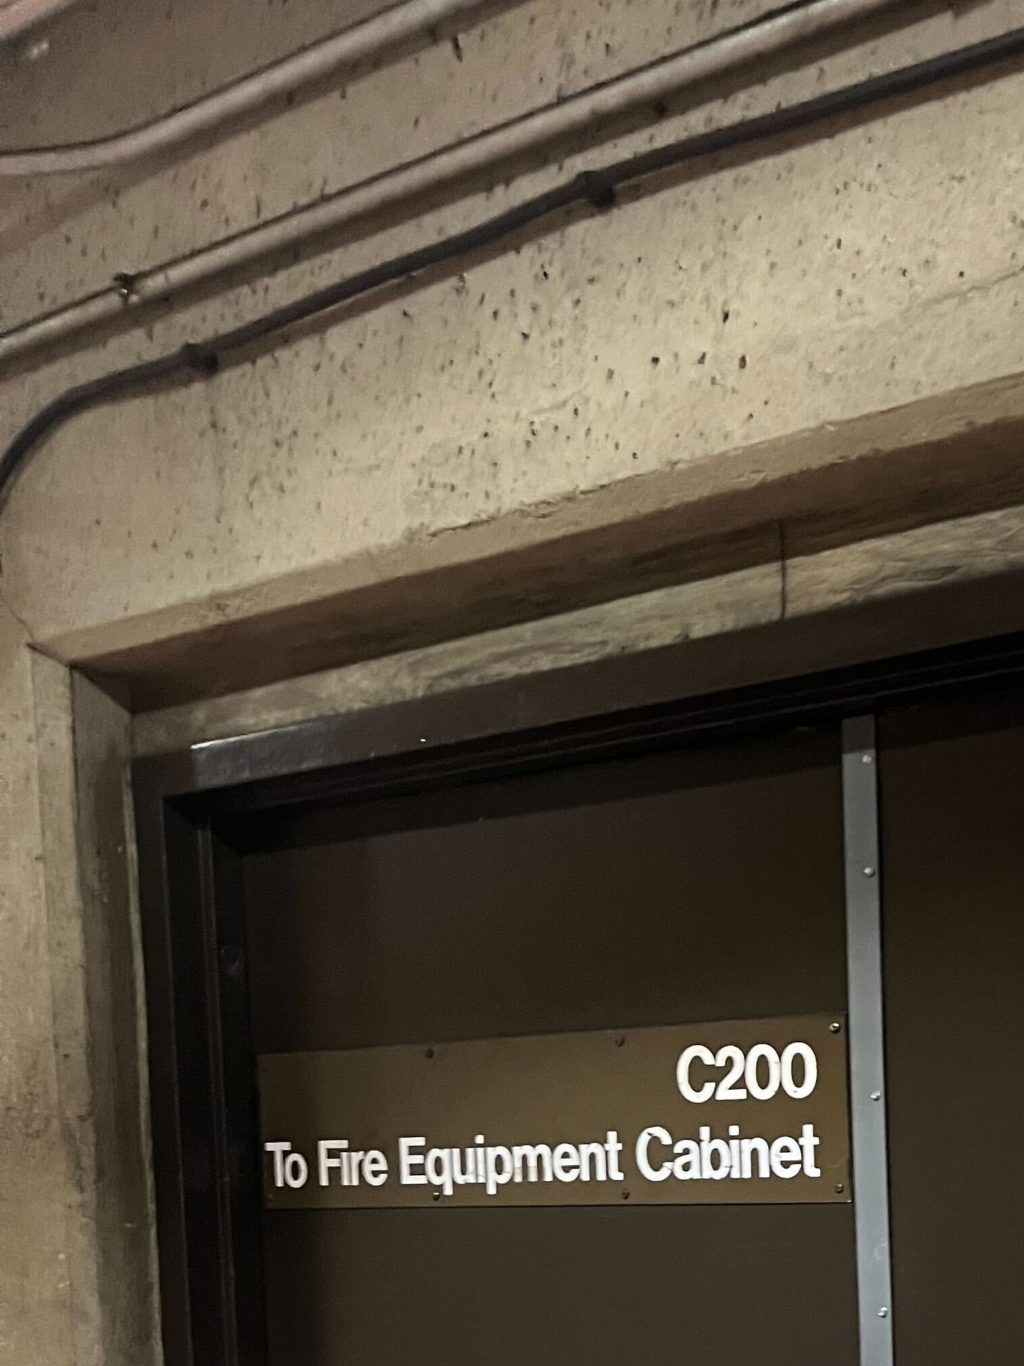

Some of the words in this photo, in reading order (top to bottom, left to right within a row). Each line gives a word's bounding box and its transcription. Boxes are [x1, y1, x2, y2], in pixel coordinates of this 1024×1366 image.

[676, 1041, 818, 1103] C200
[264, 1141, 308, 1189] To
[317, 1140, 389, 1187] Fire
[399, 1131, 624, 1196] Equipment
[635, 1124, 821, 1183] Cabinet
